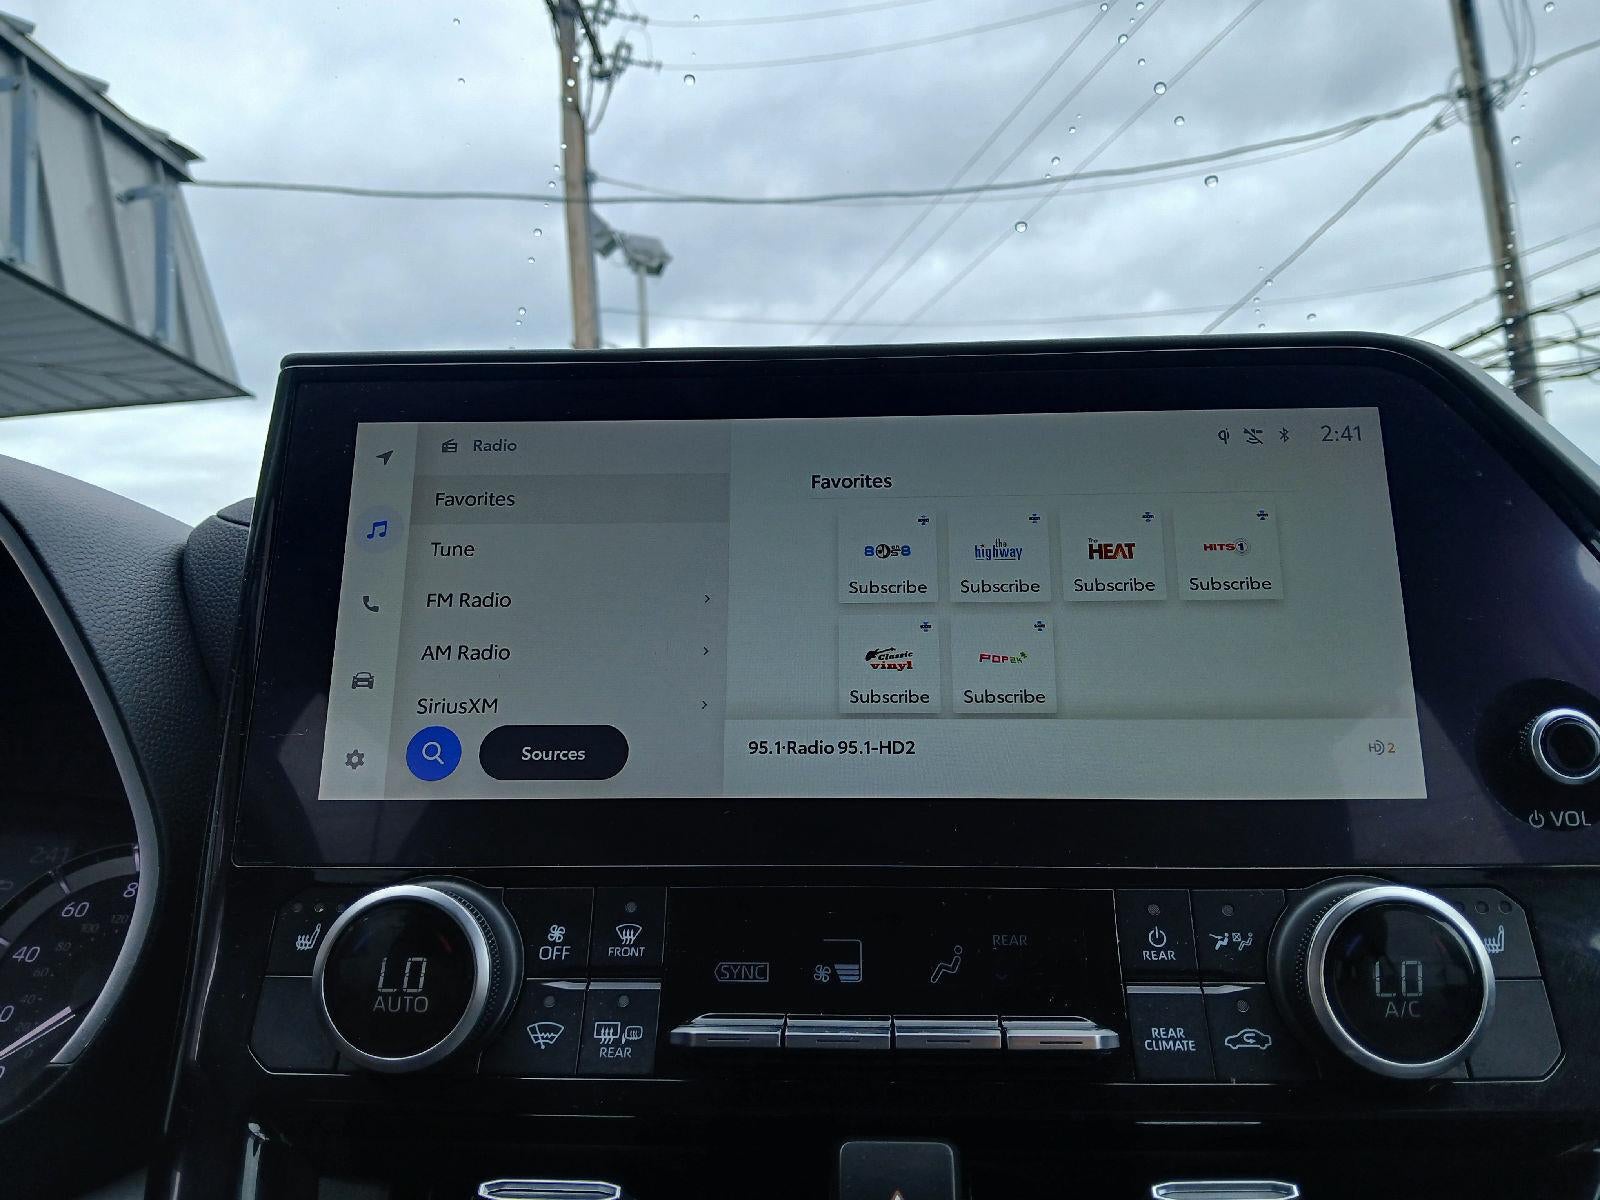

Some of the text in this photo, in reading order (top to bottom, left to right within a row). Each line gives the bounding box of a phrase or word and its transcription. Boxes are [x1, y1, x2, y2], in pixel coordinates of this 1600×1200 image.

[1320, 424, 1362, 442] 2:41
[473, 439, 518, 452] Radio
[811, 472, 892, 489] Favorites
[435, 492, 516, 507] Favorites
[431, 541, 476, 558] Tune
[995, 538, 1007, 548] the
[974, 544, 1023, 561] highway
[1088, 543, 1136, 560] HEAT
[849, 580, 928, 594] Subscribe
[960, 579, 1041, 593] Subscribe
[1074, 578, 1156, 592] Subscribe
[1189, 576, 1272, 591] Subscribe
[426, 592, 512, 608] FM Radio
[421, 644, 511, 661] AM Radio
[877, 651, 914, 661] Classic
[870, 660, 914, 672] vinyl
[850, 689, 930, 704] Subscribe
[964, 689, 1046, 704] Subscribe
[417, 698, 499, 715] SiriusXM
[521, 746, 587, 762] Sources
[837, 740, 916, 755] 95.1-HD2
[1550, 811, 1592, 827] VOL
[61, 902, 90, 918] 60
[992, 934, 1028, 947] REAR
[12, 946, 41, 963] 40
[538, 945, 571, 961] OFF
[608, 946, 646, 958] FRONT
[1142, 950, 1176, 962] REAR
[377, 956, 428, 994] LO
[719, 964, 766, 981] SYNC
[1373, 960, 1424, 998] LO
[372, 996, 429, 1014] AUTO
[1385, 1001, 1421, 1018] A/C
[1151, 1027, 1186, 1040] REAR
[599, 1046, 632, 1059] REAR
[1144, 1040, 1196, 1053] CLIMATE
